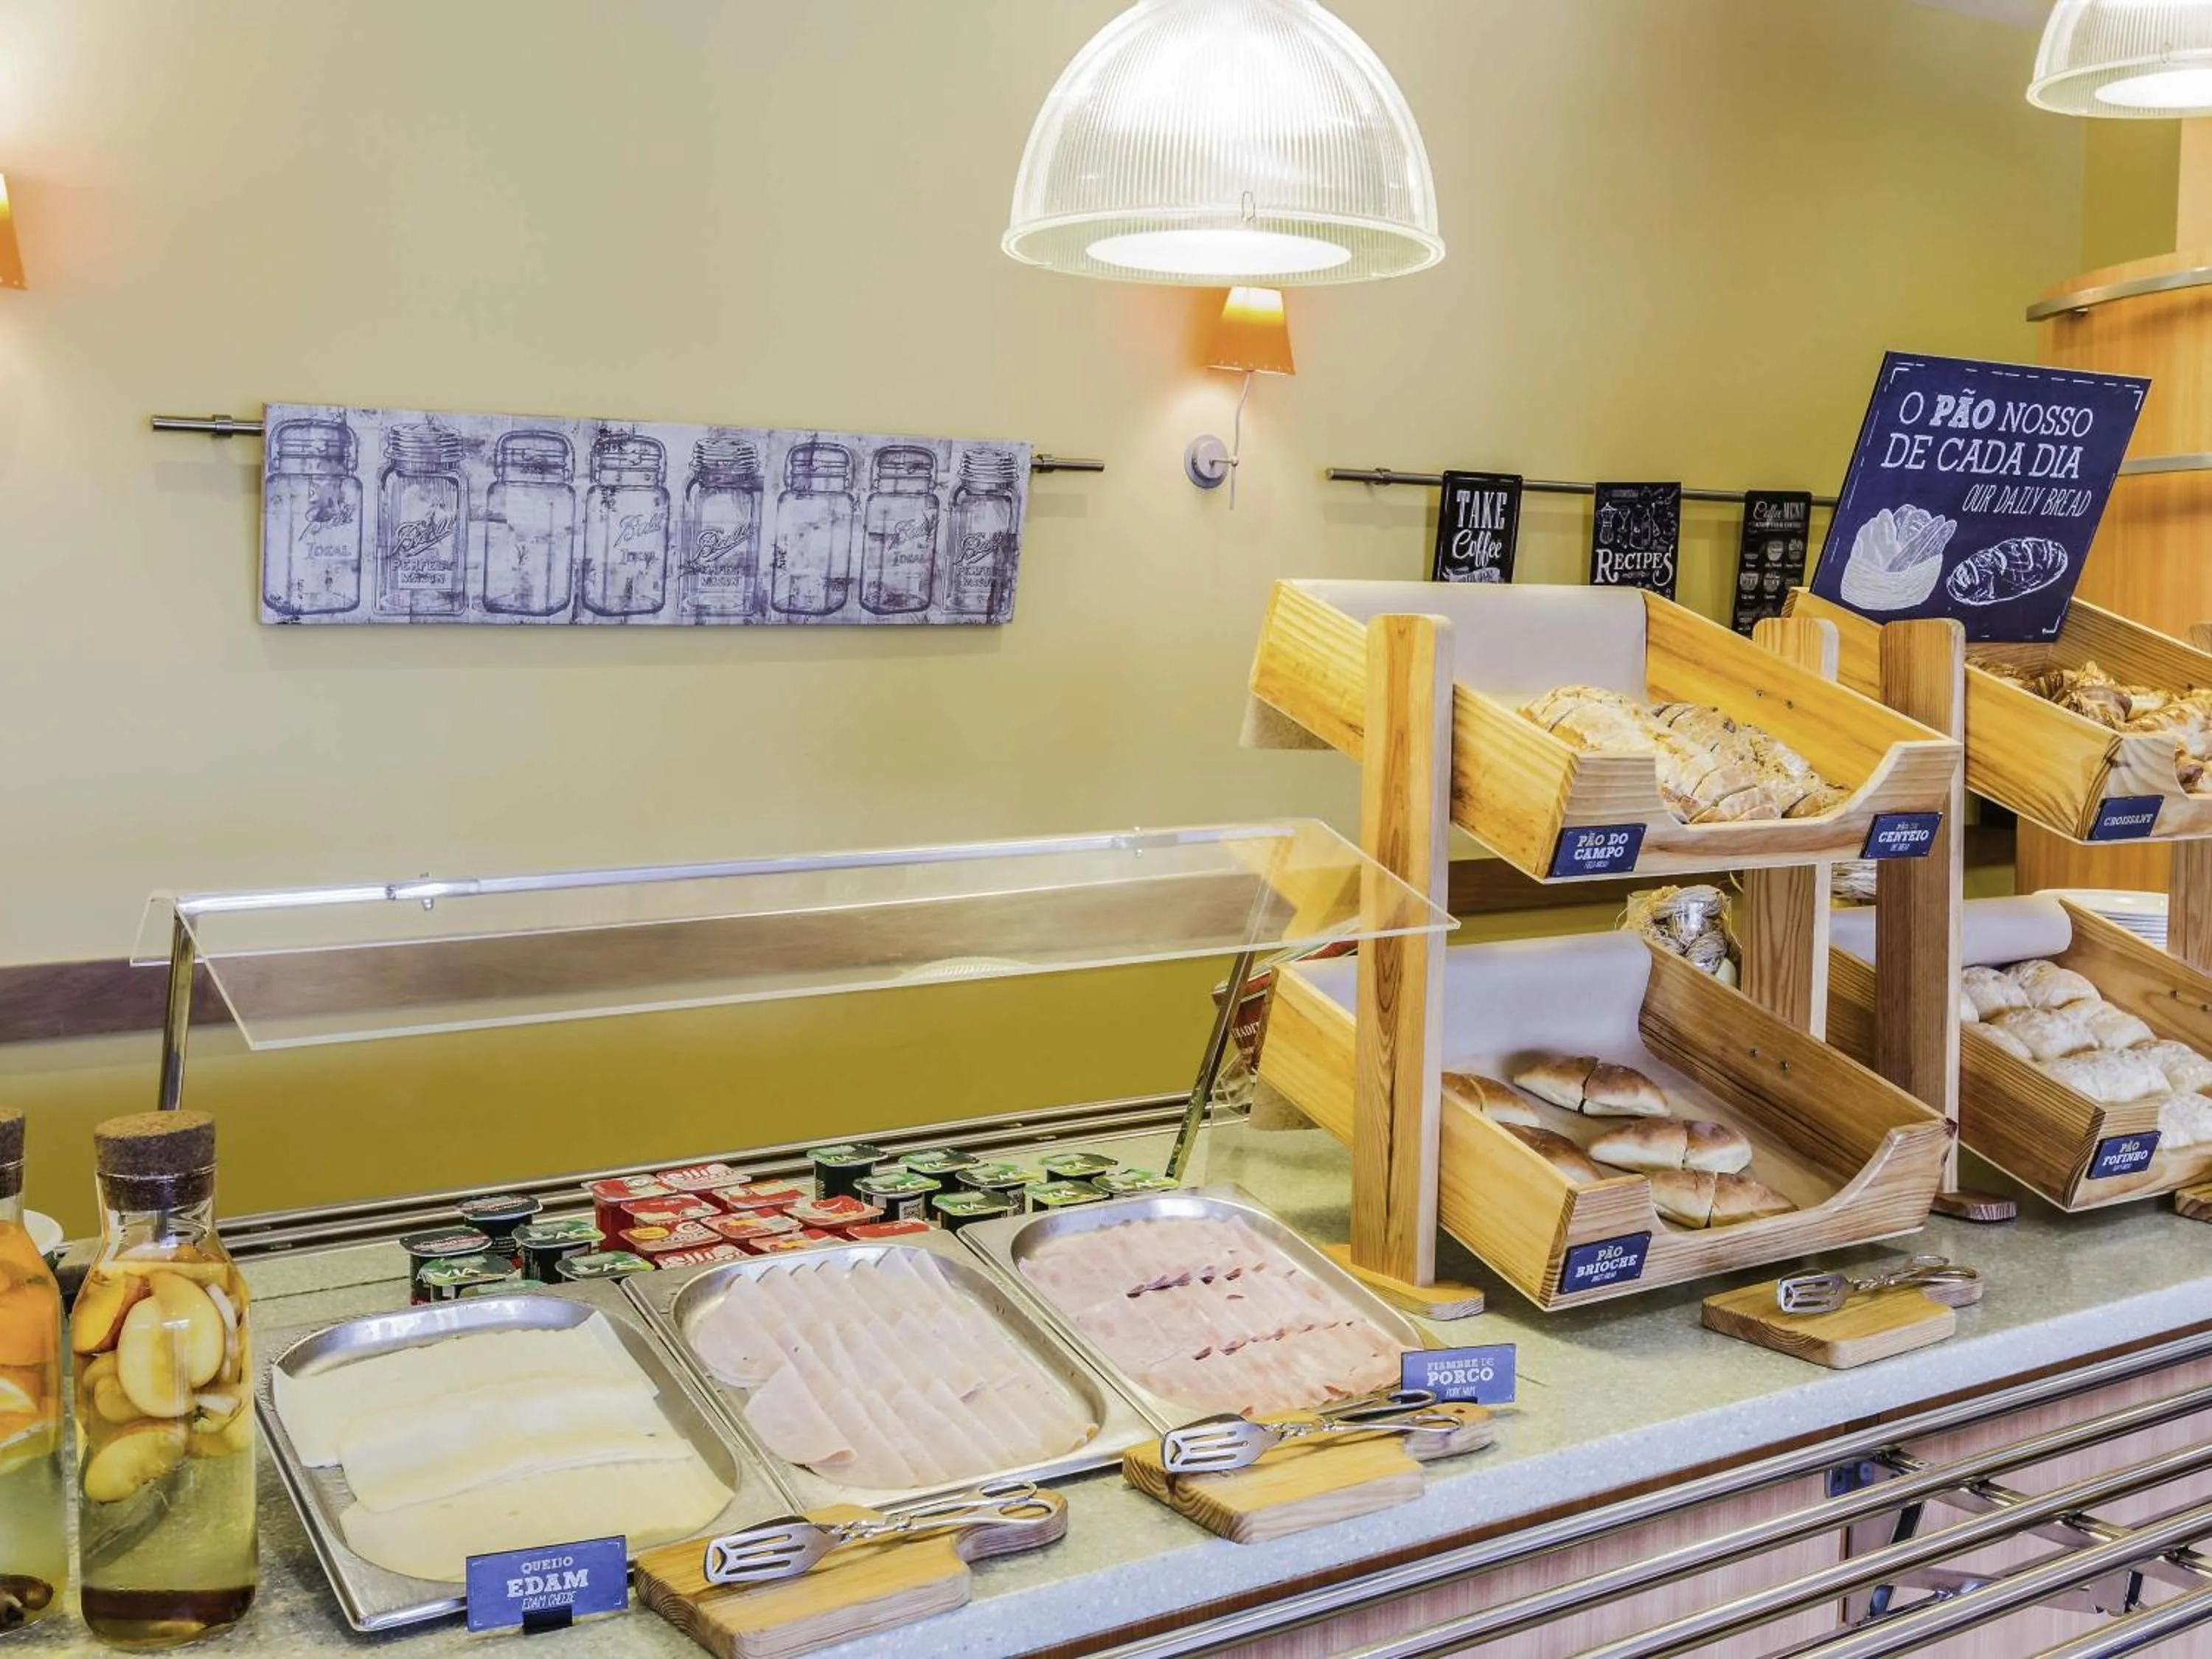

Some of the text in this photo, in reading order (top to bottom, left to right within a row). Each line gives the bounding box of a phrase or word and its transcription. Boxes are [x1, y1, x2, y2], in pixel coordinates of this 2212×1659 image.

[1899, 389, 2094, 437] O PÃO NOSSO
[1881, 433, 2084, 479] DE CADA DIA
[1456, 490, 1508, 529] TAKE
[1962, 484, 2093, 517] OUR DAILY BREAD
[1452, 529, 1502, 567] Coffee
[1576, 830, 1629, 847] PÃO DO
[1878, 830, 1930, 843] CENTEIO
[1573, 846, 1624, 861] CAMPO
[1596, 1245, 1624, 1262] PÃO
[1574, 1254, 1638, 1279] BRIOCHE
[1427, 1359, 1478, 1371] FIAMBRE
[1427, 1367, 1495, 1387] PORCO
[521, 1557, 574, 1574] QUEIJO
[506, 1568, 589, 1599] EDAM
